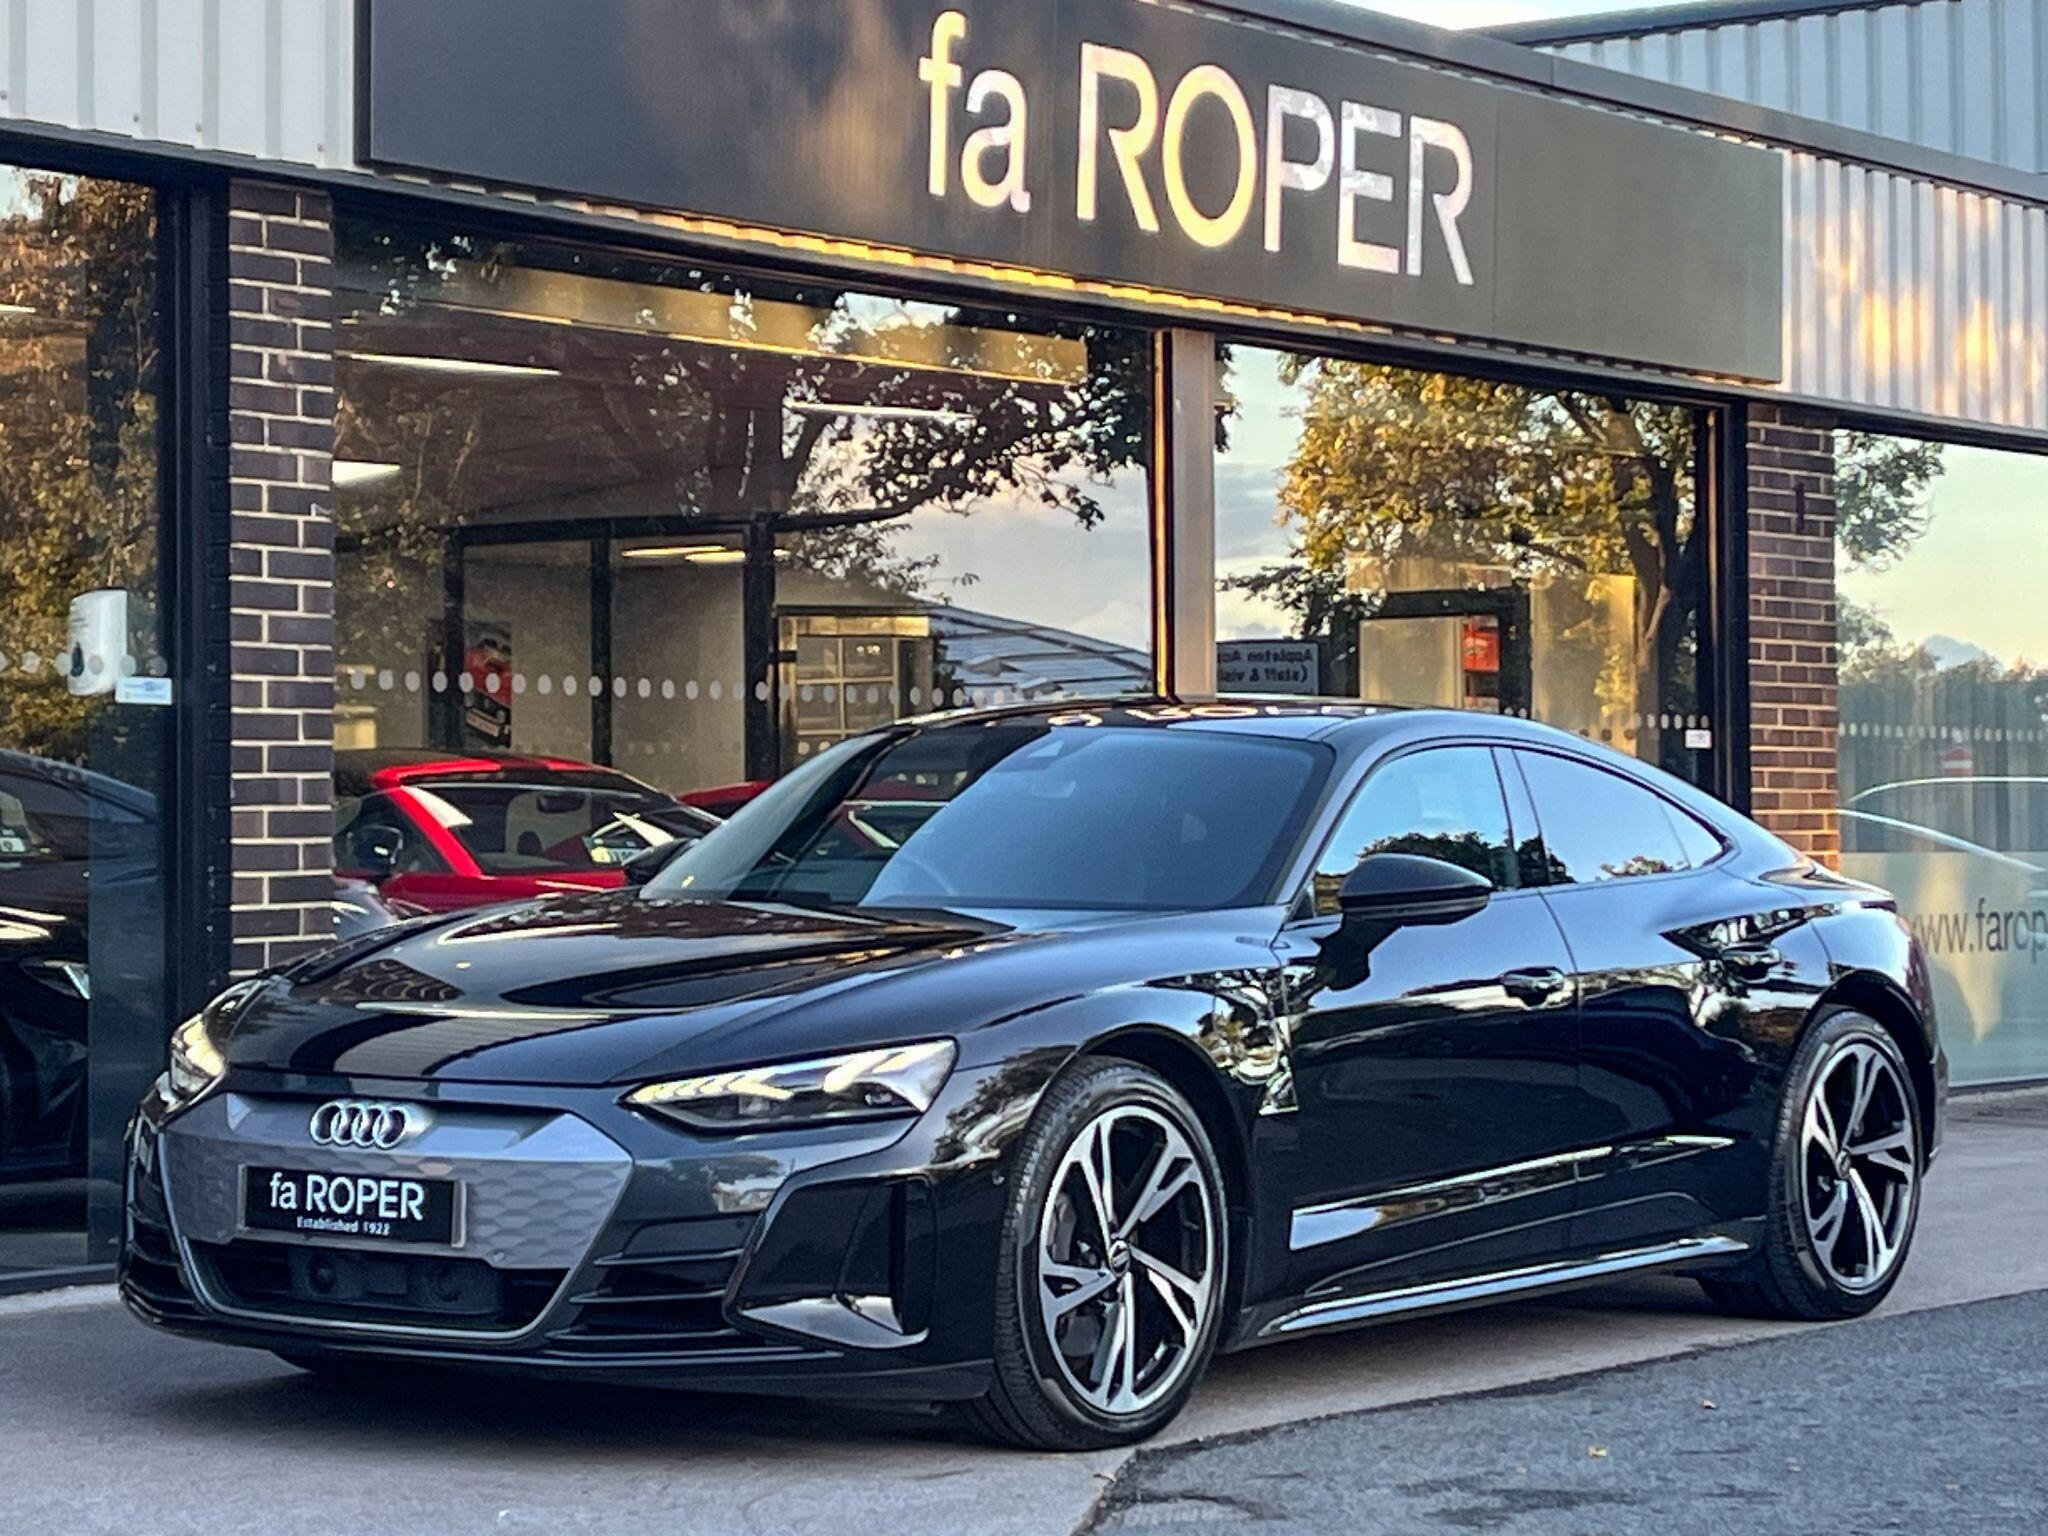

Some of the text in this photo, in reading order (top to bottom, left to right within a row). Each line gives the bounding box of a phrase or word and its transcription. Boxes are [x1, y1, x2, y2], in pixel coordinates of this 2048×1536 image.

[918, 9, 1474, 286] fa ROPER
[270, 1172, 424, 1221] fa ROPER
